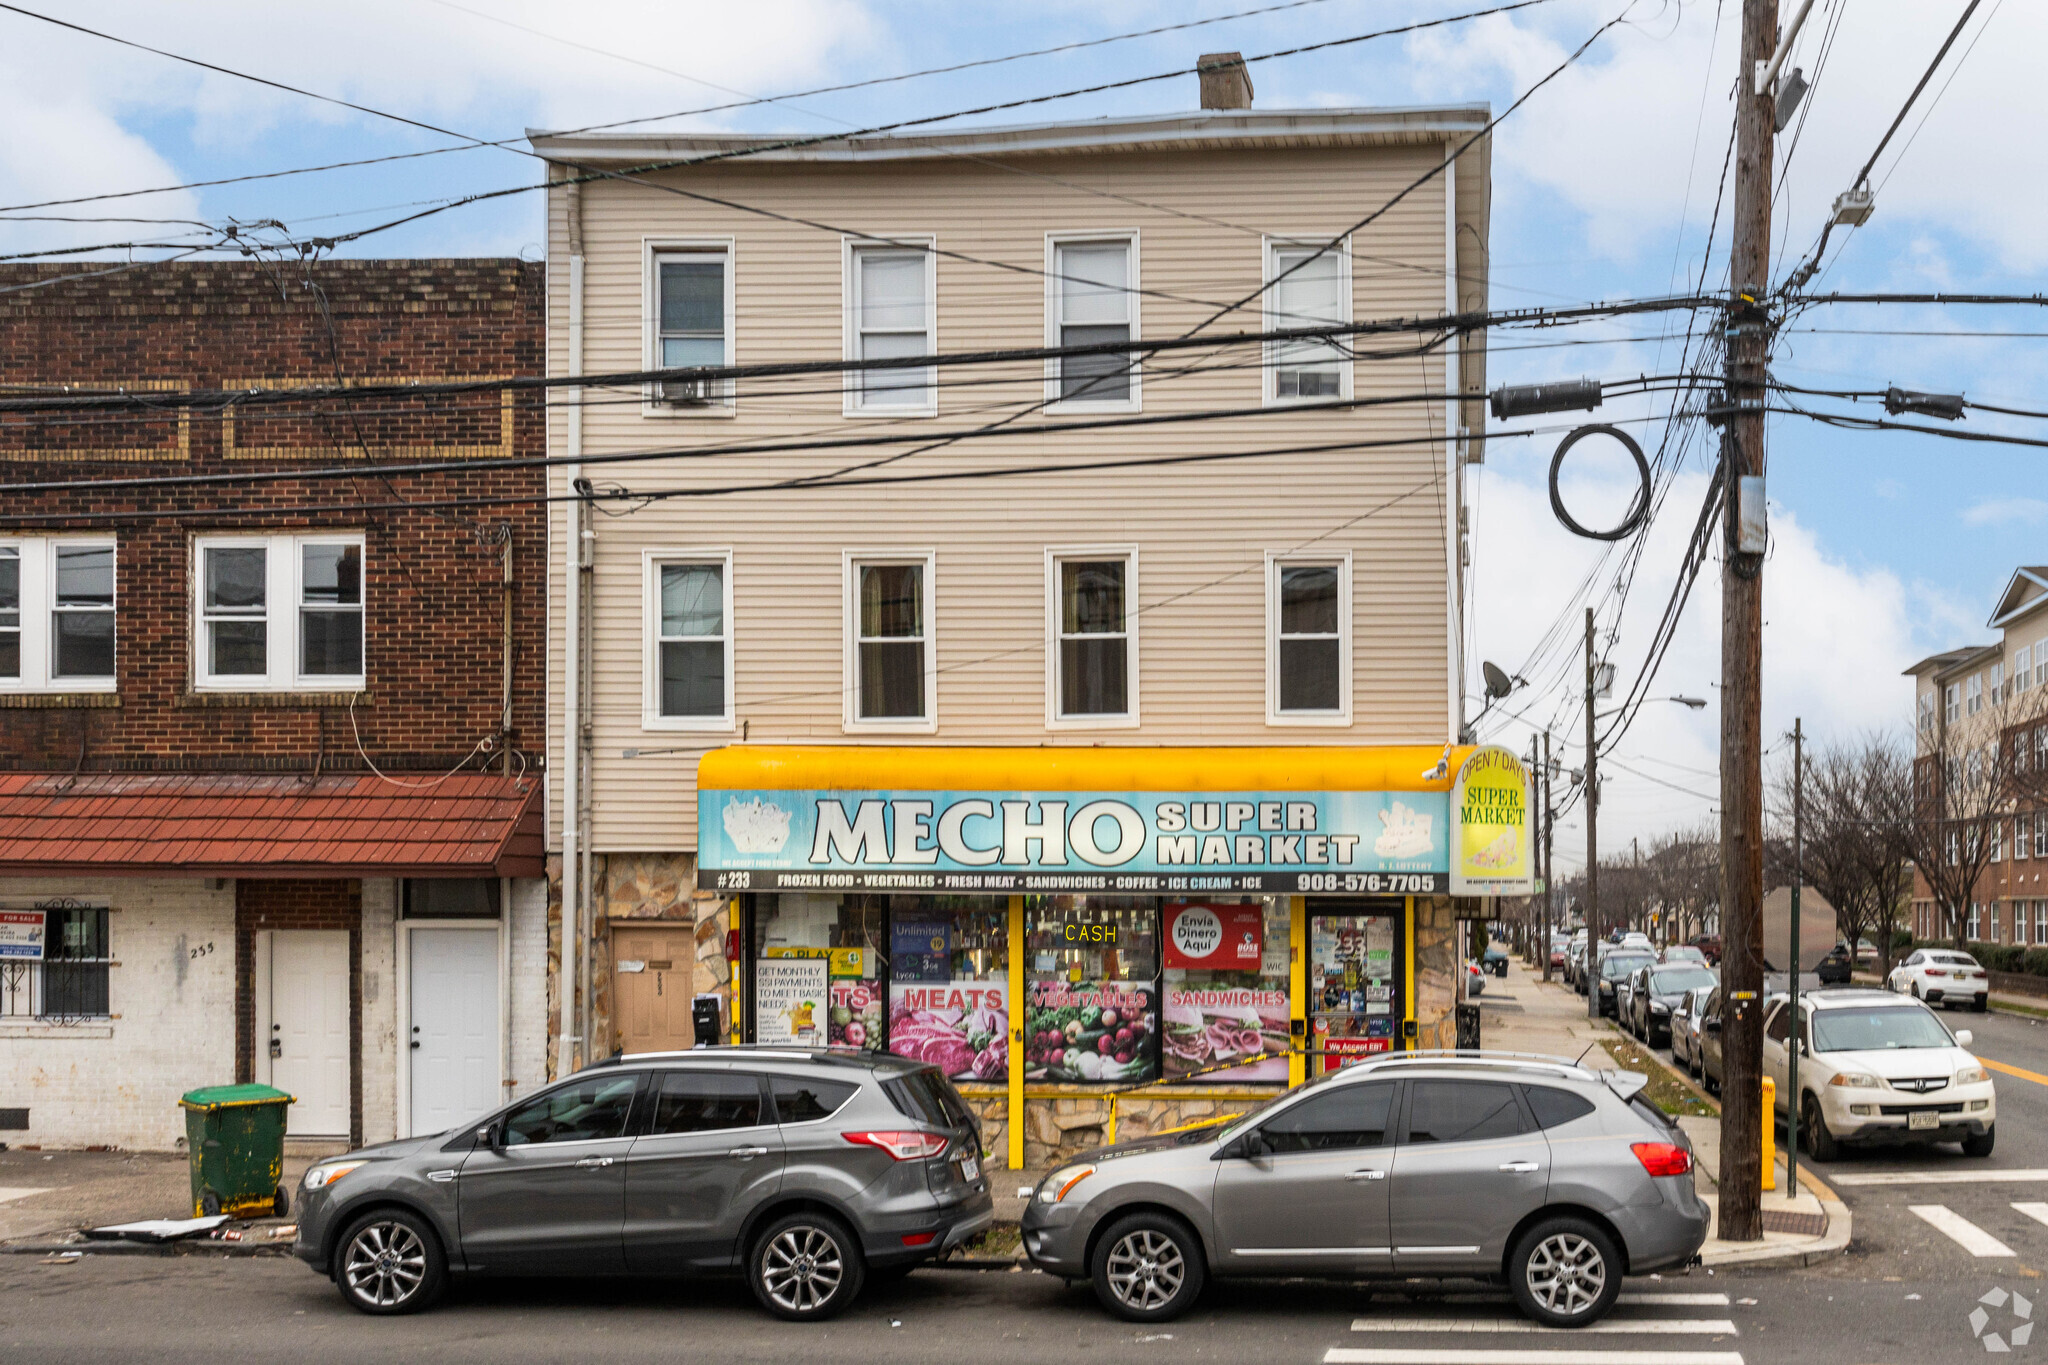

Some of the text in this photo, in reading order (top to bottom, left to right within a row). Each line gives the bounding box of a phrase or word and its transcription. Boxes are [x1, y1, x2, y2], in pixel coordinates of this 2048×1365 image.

[1462, 750, 1526, 787] OPEN 7 DAYS
[1467, 786, 1518, 806] SUPER
[1155, 801, 1317, 831] SUPER
[1460, 806, 1525, 825] MARKET
[808, 799, 1147, 867] MECHO
[1155, 834, 1360, 866] MARKET
[777, 874, 1262, 889] FROZEN FOOD VEGETABLES FRESH MEAT SANDWICHES COFFEE ICE CREAM ICE
[1297, 873, 1435, 893] 908-576-7705
[1181, 915, 1213, 927] Envía
[896, 925, 945, 936] Unlimited
[1065, 924, 1116, 943] CASH
[1178, 926, 1217, 938] Dinero
[1183, 938, 1211, 952] Aquí
[758, 967, 821, 976] GET MONTHLY
[1266, 962, 1282, 972] WIC
[758, 978, 823, 987] SSI PAYMENTS
[759, 989, 826, 998] TO MEET BASIC
[904, 988, 1003, 1010] MEATS
[1033, 992, 1148, 1008] VEGETABLES
[1171, 990, 1286, 1008] SANDWICHES
[758, 1000, 787, 1009] NEEDS
[1329, 1043, 1383, 1052] We Accept EBT
